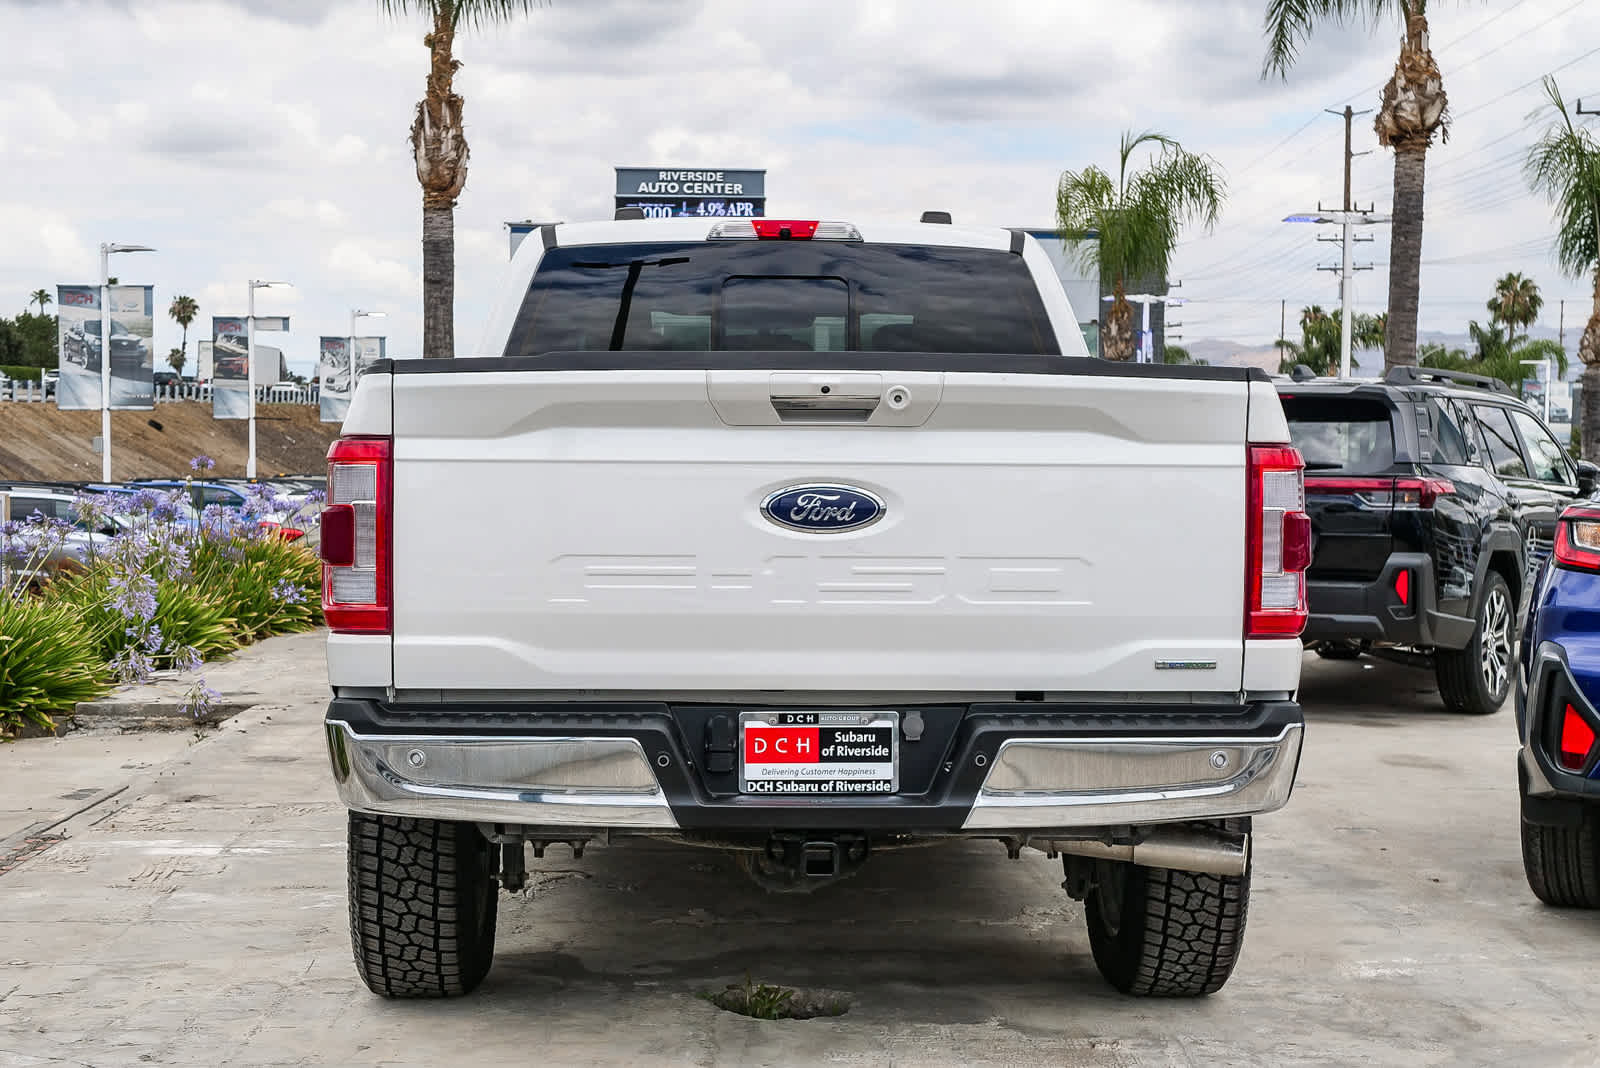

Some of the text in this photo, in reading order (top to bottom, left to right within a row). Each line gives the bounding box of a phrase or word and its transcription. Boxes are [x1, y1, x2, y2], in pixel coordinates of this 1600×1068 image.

[659, 171, 724, 182] RIVERSIDE
[637, 182, 743, 194] AUTO CENTER
[696, 202, 754, 216] 4.9% APR
[65, 293, 93, 304] DCH
[790, 493, 857, 521] Ford
[835, 731, 876, 743] Subaru
[754, 737, 810, 754] DCH
[821, 745, 889, 757] of Riverside
[761, 767, 876, 777] Delivering Customer Happiness
[747, 780, 891, 792] DCH Subaru of Riverside
